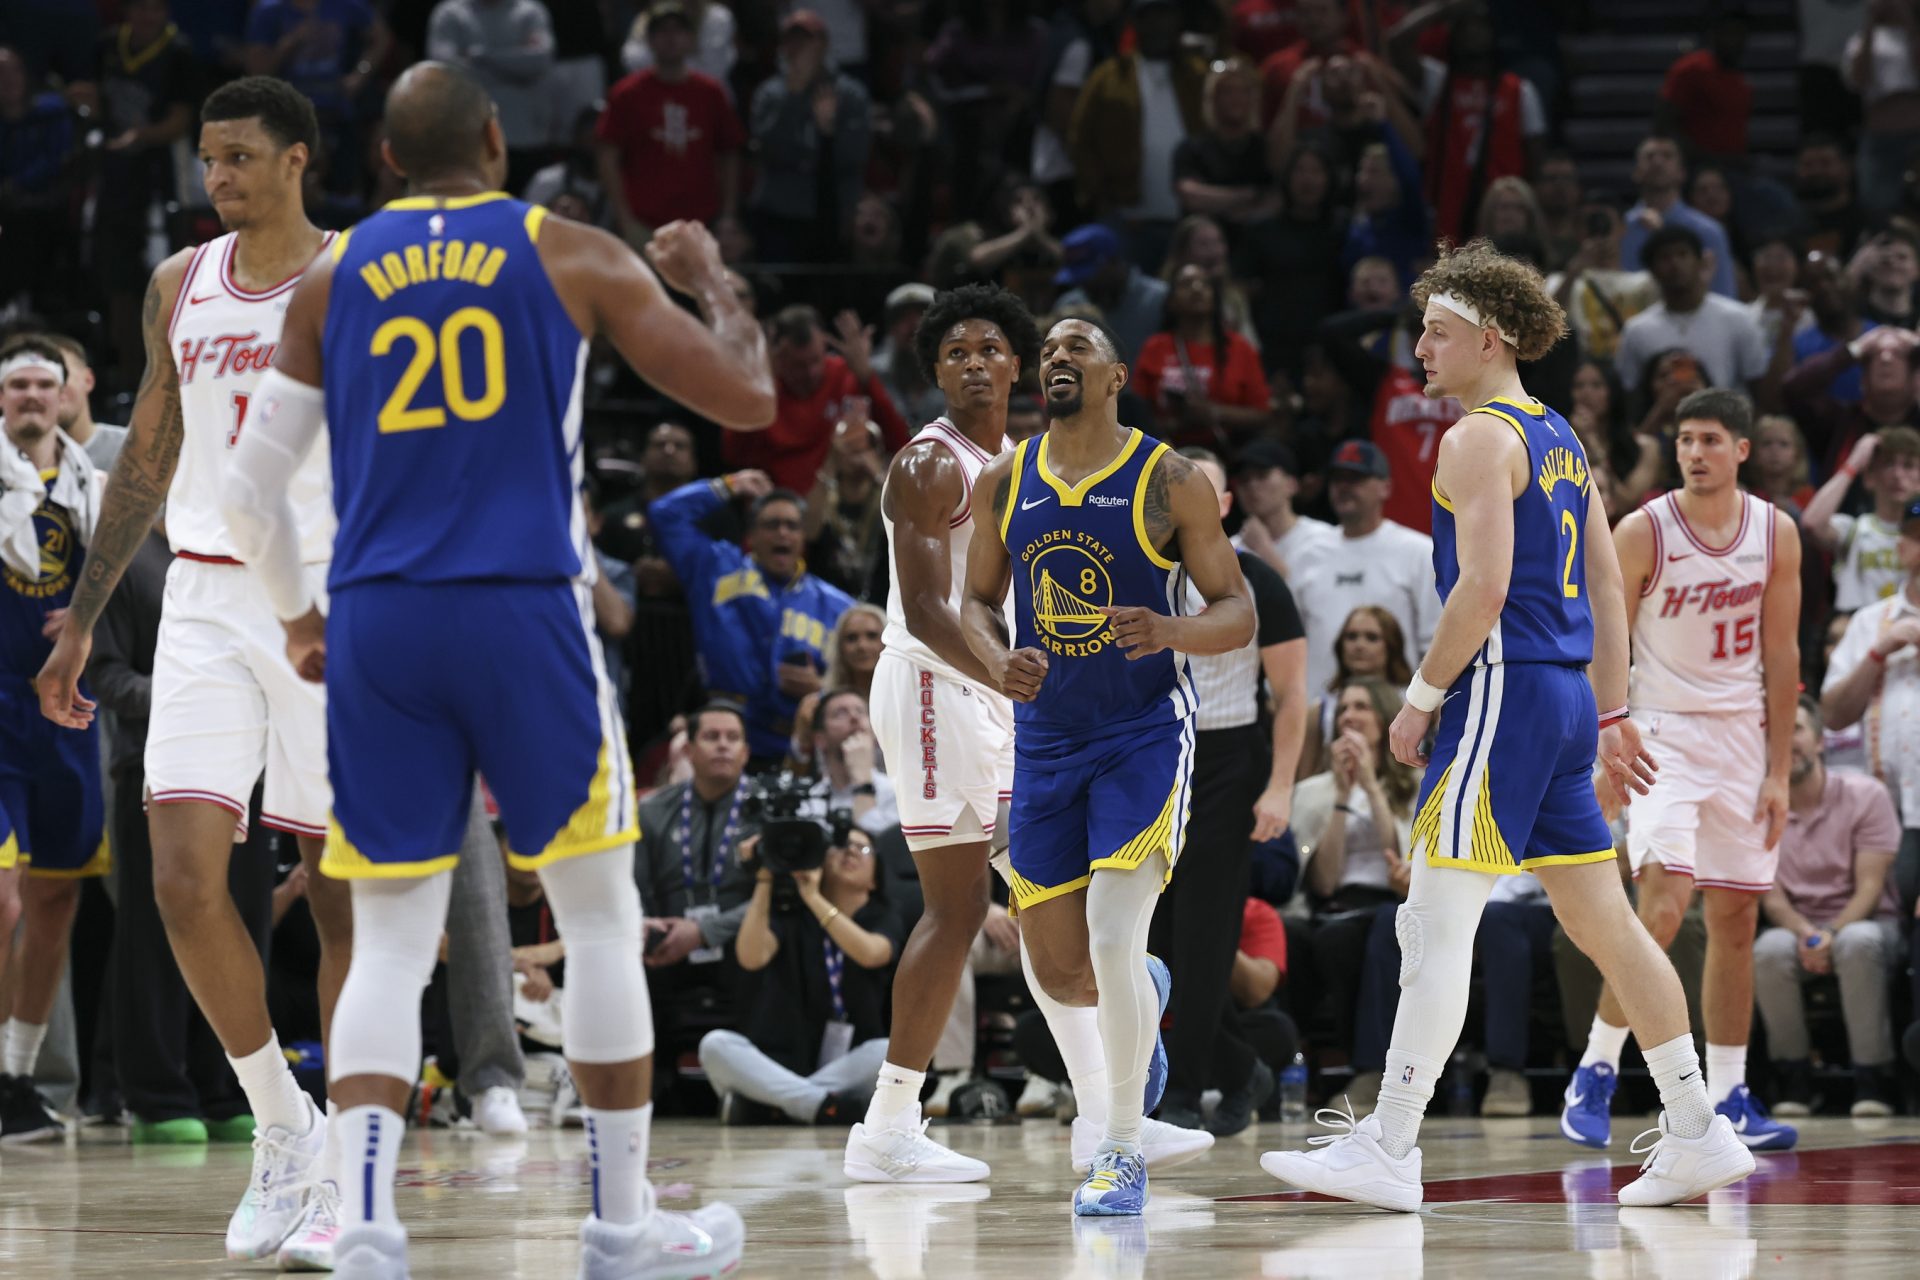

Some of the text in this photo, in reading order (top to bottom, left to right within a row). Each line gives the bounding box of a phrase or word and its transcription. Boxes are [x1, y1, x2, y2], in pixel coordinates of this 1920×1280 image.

[359, 240, 507, 301] HORFORD
[370, 306, 507, 434] 20
[1088, 494, 1129, 507] Rakuten
[1021, 529, 1115, 564] GOLDEN STATE
[1561, 509, 1578, 598] 2
[1080, 568, 1097, 595] 8
[1659, 577, 1762, 618] H-Town
[1033, 617, 1117, 657] WARRIOR
[1710, 614, 1756, 661] 15
[920, 670, 937, 800] ROCKETS
